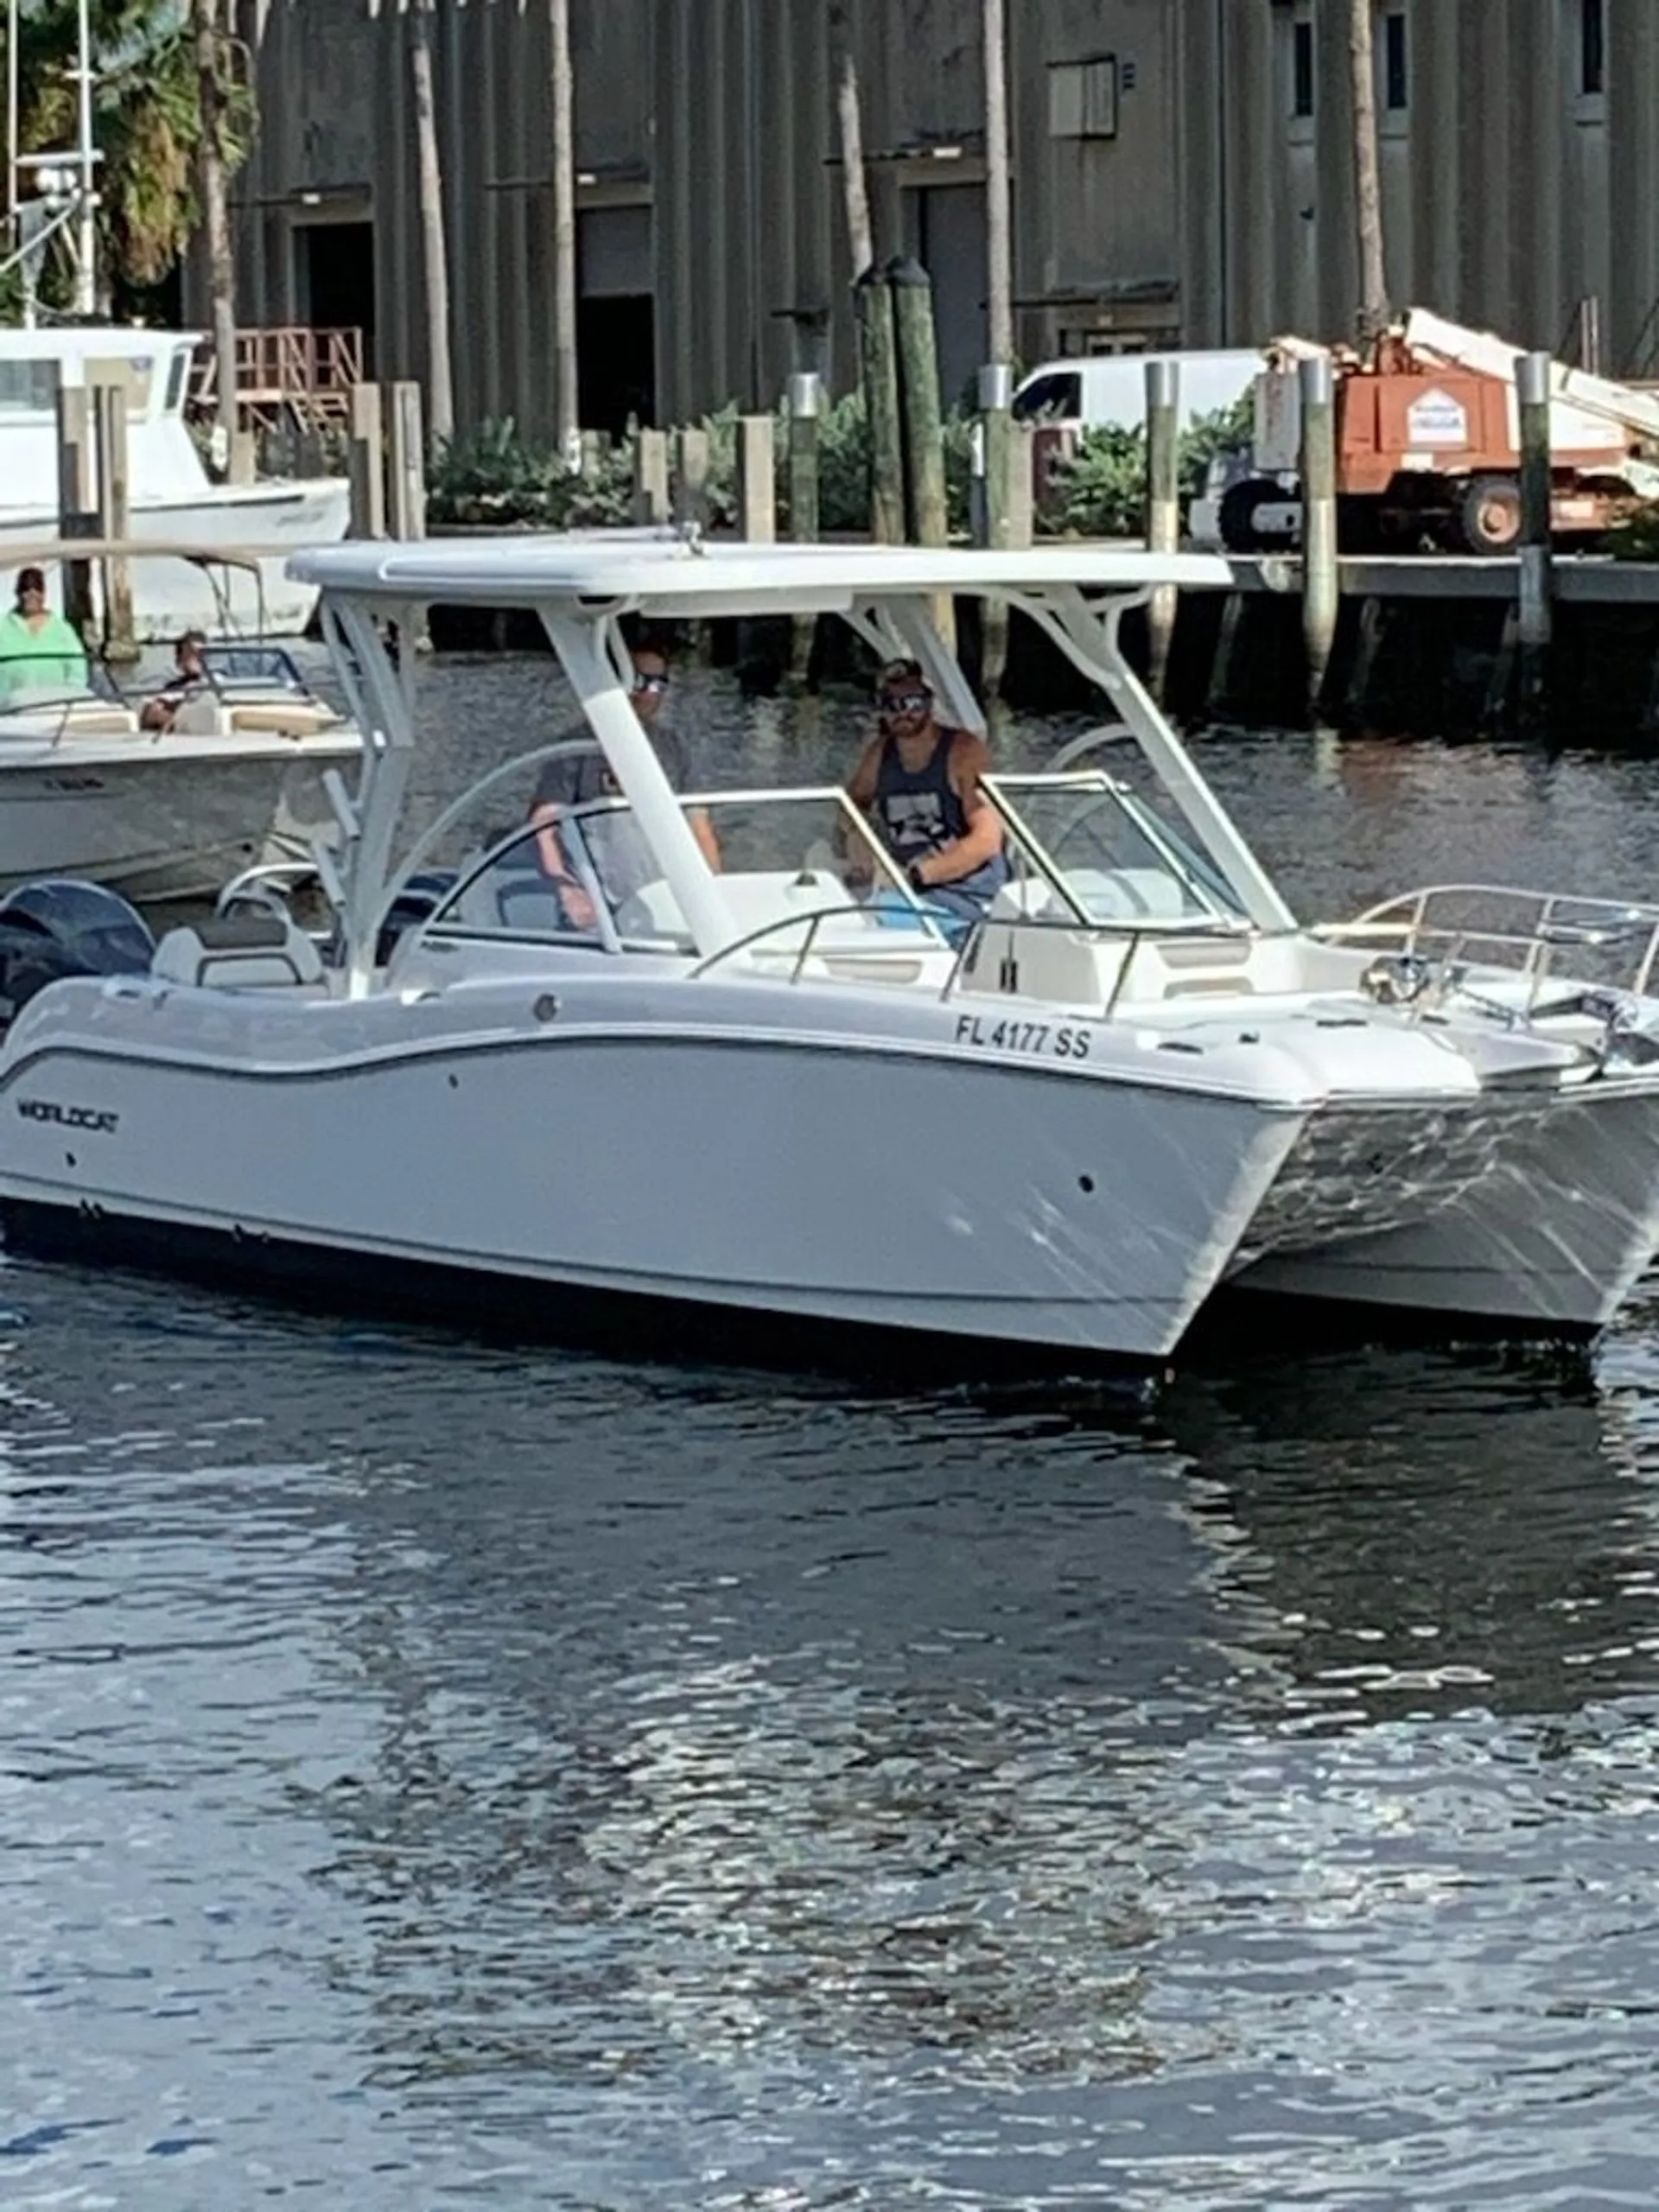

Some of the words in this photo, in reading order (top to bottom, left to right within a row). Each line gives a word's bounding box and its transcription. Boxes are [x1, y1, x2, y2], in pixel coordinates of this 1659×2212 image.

[956, 1014, 985, 1046] FL
[991, 1020, 1050, 1052] 4177
[1053, 1027, 1091, 1059] SS
